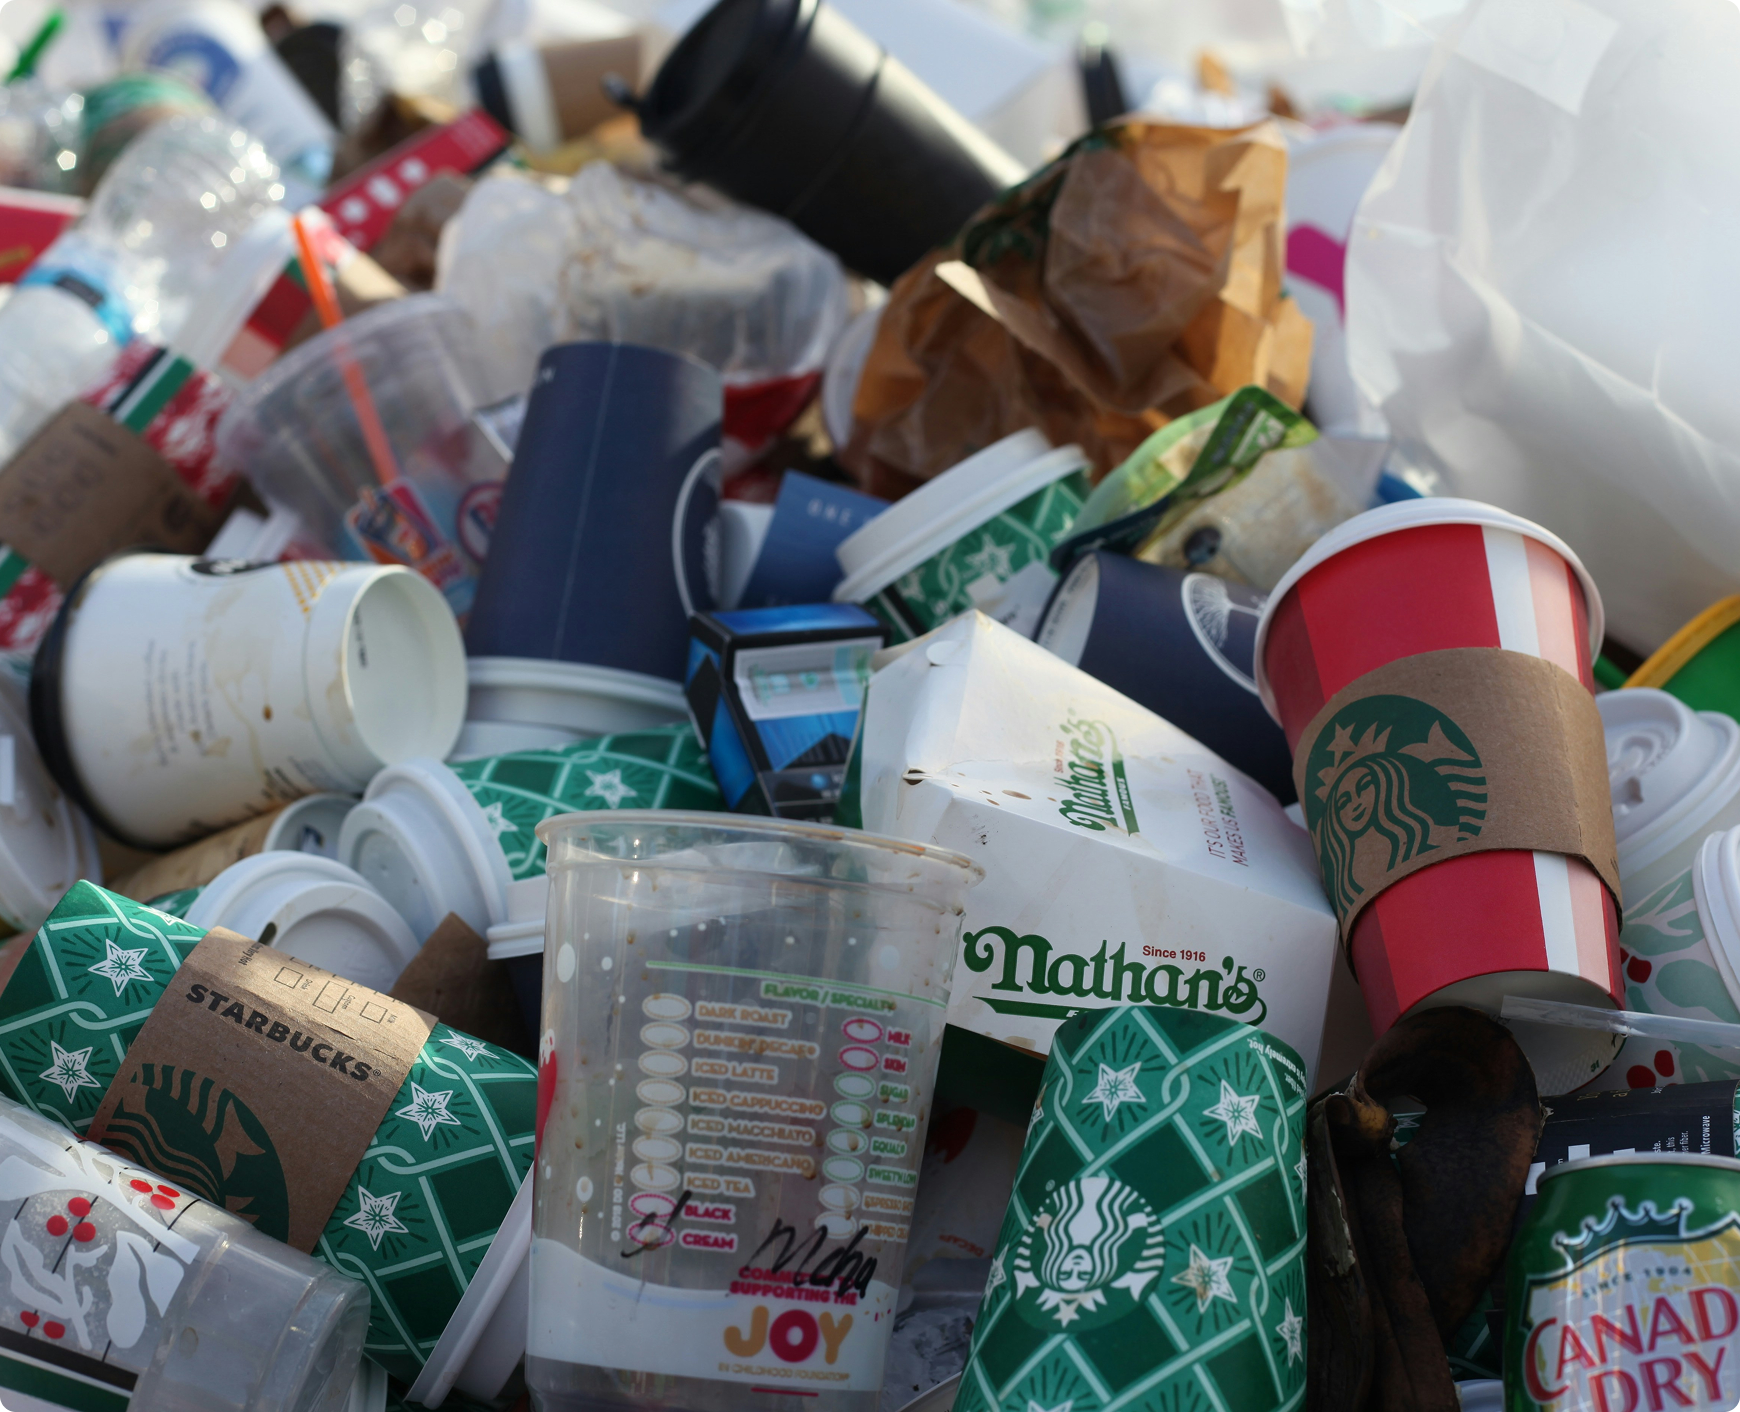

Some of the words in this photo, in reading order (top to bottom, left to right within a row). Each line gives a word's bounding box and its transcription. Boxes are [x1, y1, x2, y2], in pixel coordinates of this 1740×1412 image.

[1117, 777, 1132, 811] FAMOUS
[1194, 793, 1214, 817] FOOD
[1203, 817, 1221, 840] OUR
[1222, 817, 1238, 832] US
[1207, 840, 1226, 859] IT'S
[1226, 832, 1249, 867] MAKES
[1143, 945, 1176, 959] Since
[1180, 949, 1206, 962] 1916
[763, 983, 819, 1001] FLAVOR
[698, 1004, 737, 1020] DARK
[740, 1009, 788, 1025] ROAST
[1247, 1037, 1264, 1054] hot.
[1265, 1045, 1297, 1073] extremely
[694, 1061, 728, 1075] ICED
[731, 1065, 775, 1081] LATTE
[692, 1091, 726, 1105] ICED
[729, 1095, 824, 1116] CAPPUCCINO
[691, 1119, 724, 1132] ICED
[728, 1123, 813, 1142] MACCHIATO
[689, 1147, 722, 1160] ICED
[725, 1150, 812, 1171] AMERICANO
[687, 1176, 720, 1190] ICED
[724, 1180, 752, 1194] TEA
[684, 1205, 732, 1221] BLACK
[682, 1233, 735, 1250] CREAM
[730, 1281, 831, 1303] SUPPORTING
[834, 1292, 857, 1306] THE
[1583, 1272, 1632, 1298] SINCE
[1644, 1266, 1691, 1278] 1904
[724, 1305, 853, 1365] JOY
[1525, 1287, 1740, 1401] CANAD
[733, 1364, 792, 1379] CHILDHOOD
[1587, 1346, 1727, 1412] DRY
